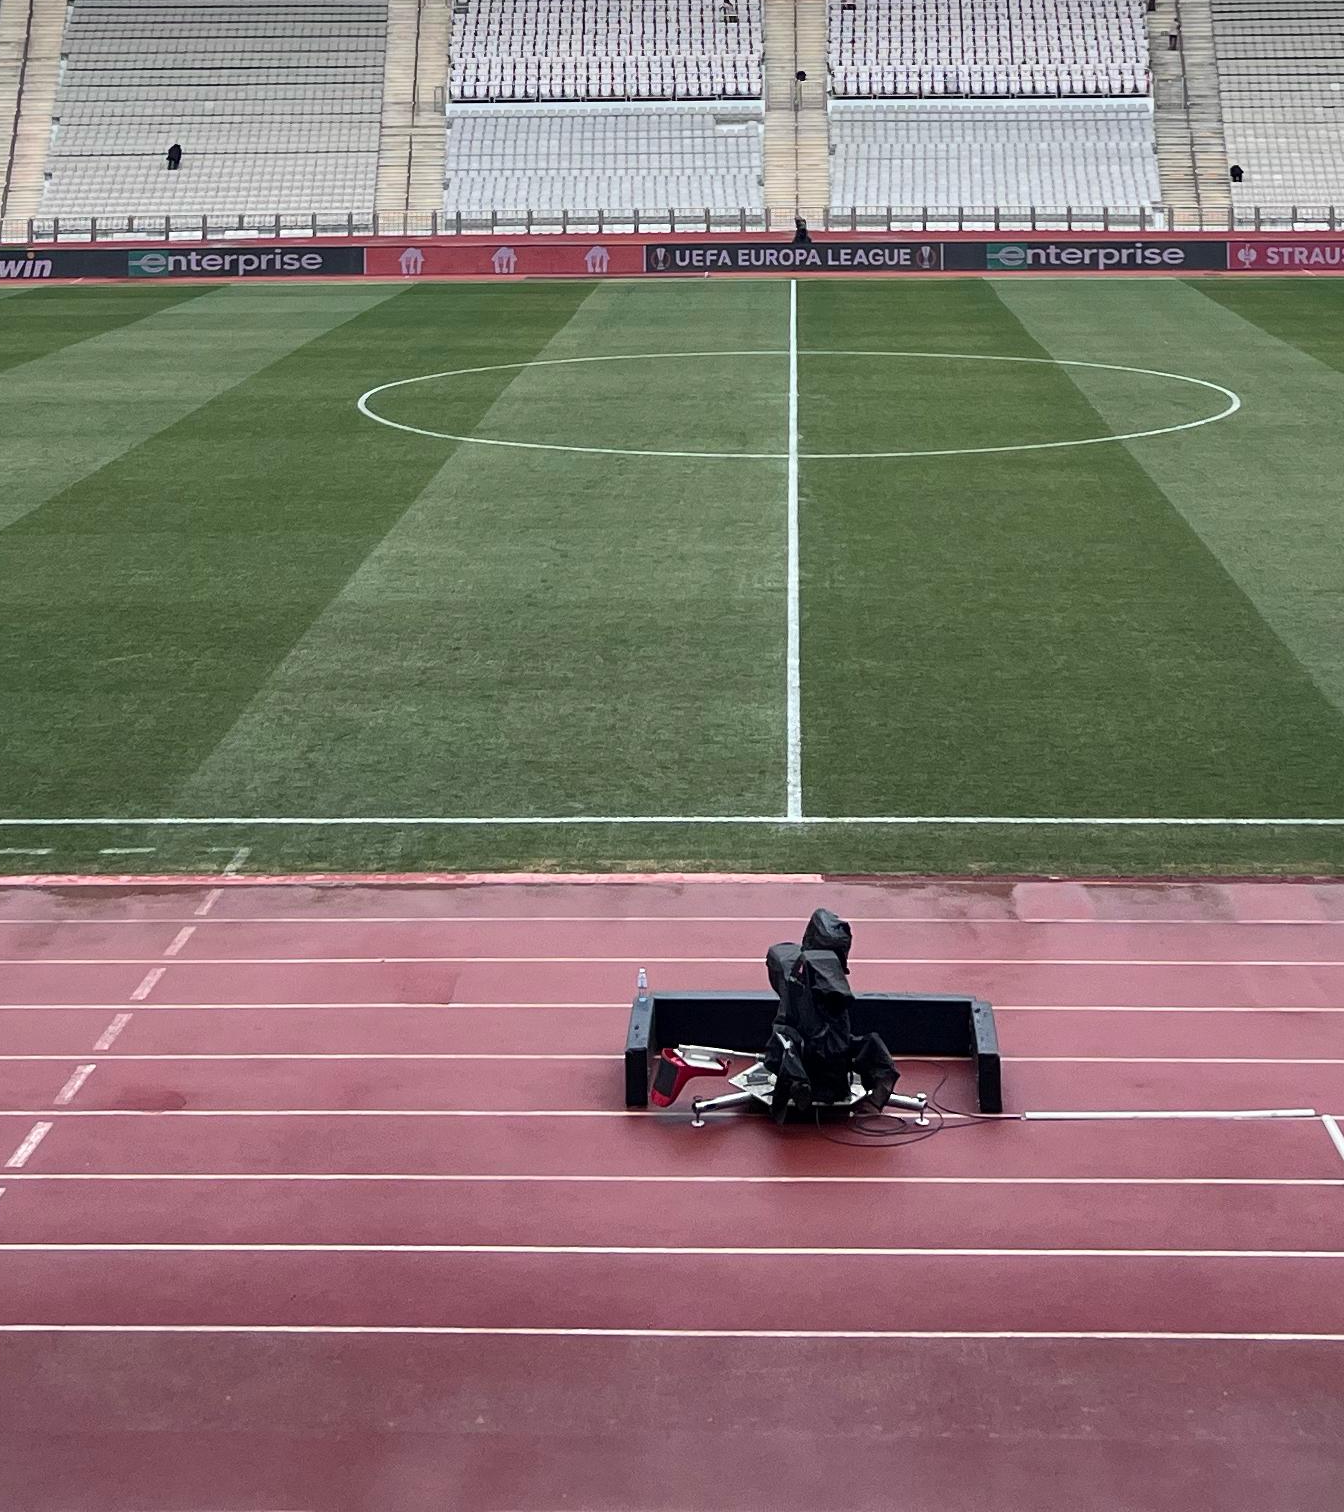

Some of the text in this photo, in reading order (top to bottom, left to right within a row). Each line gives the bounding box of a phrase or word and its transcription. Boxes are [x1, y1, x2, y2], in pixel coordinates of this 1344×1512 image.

[134, 248, 323, 276] enterprise
[675, 248, 912, 267] UEFA EUROPA LEAGUE
[993, 242, 1185, 270] enterprise
